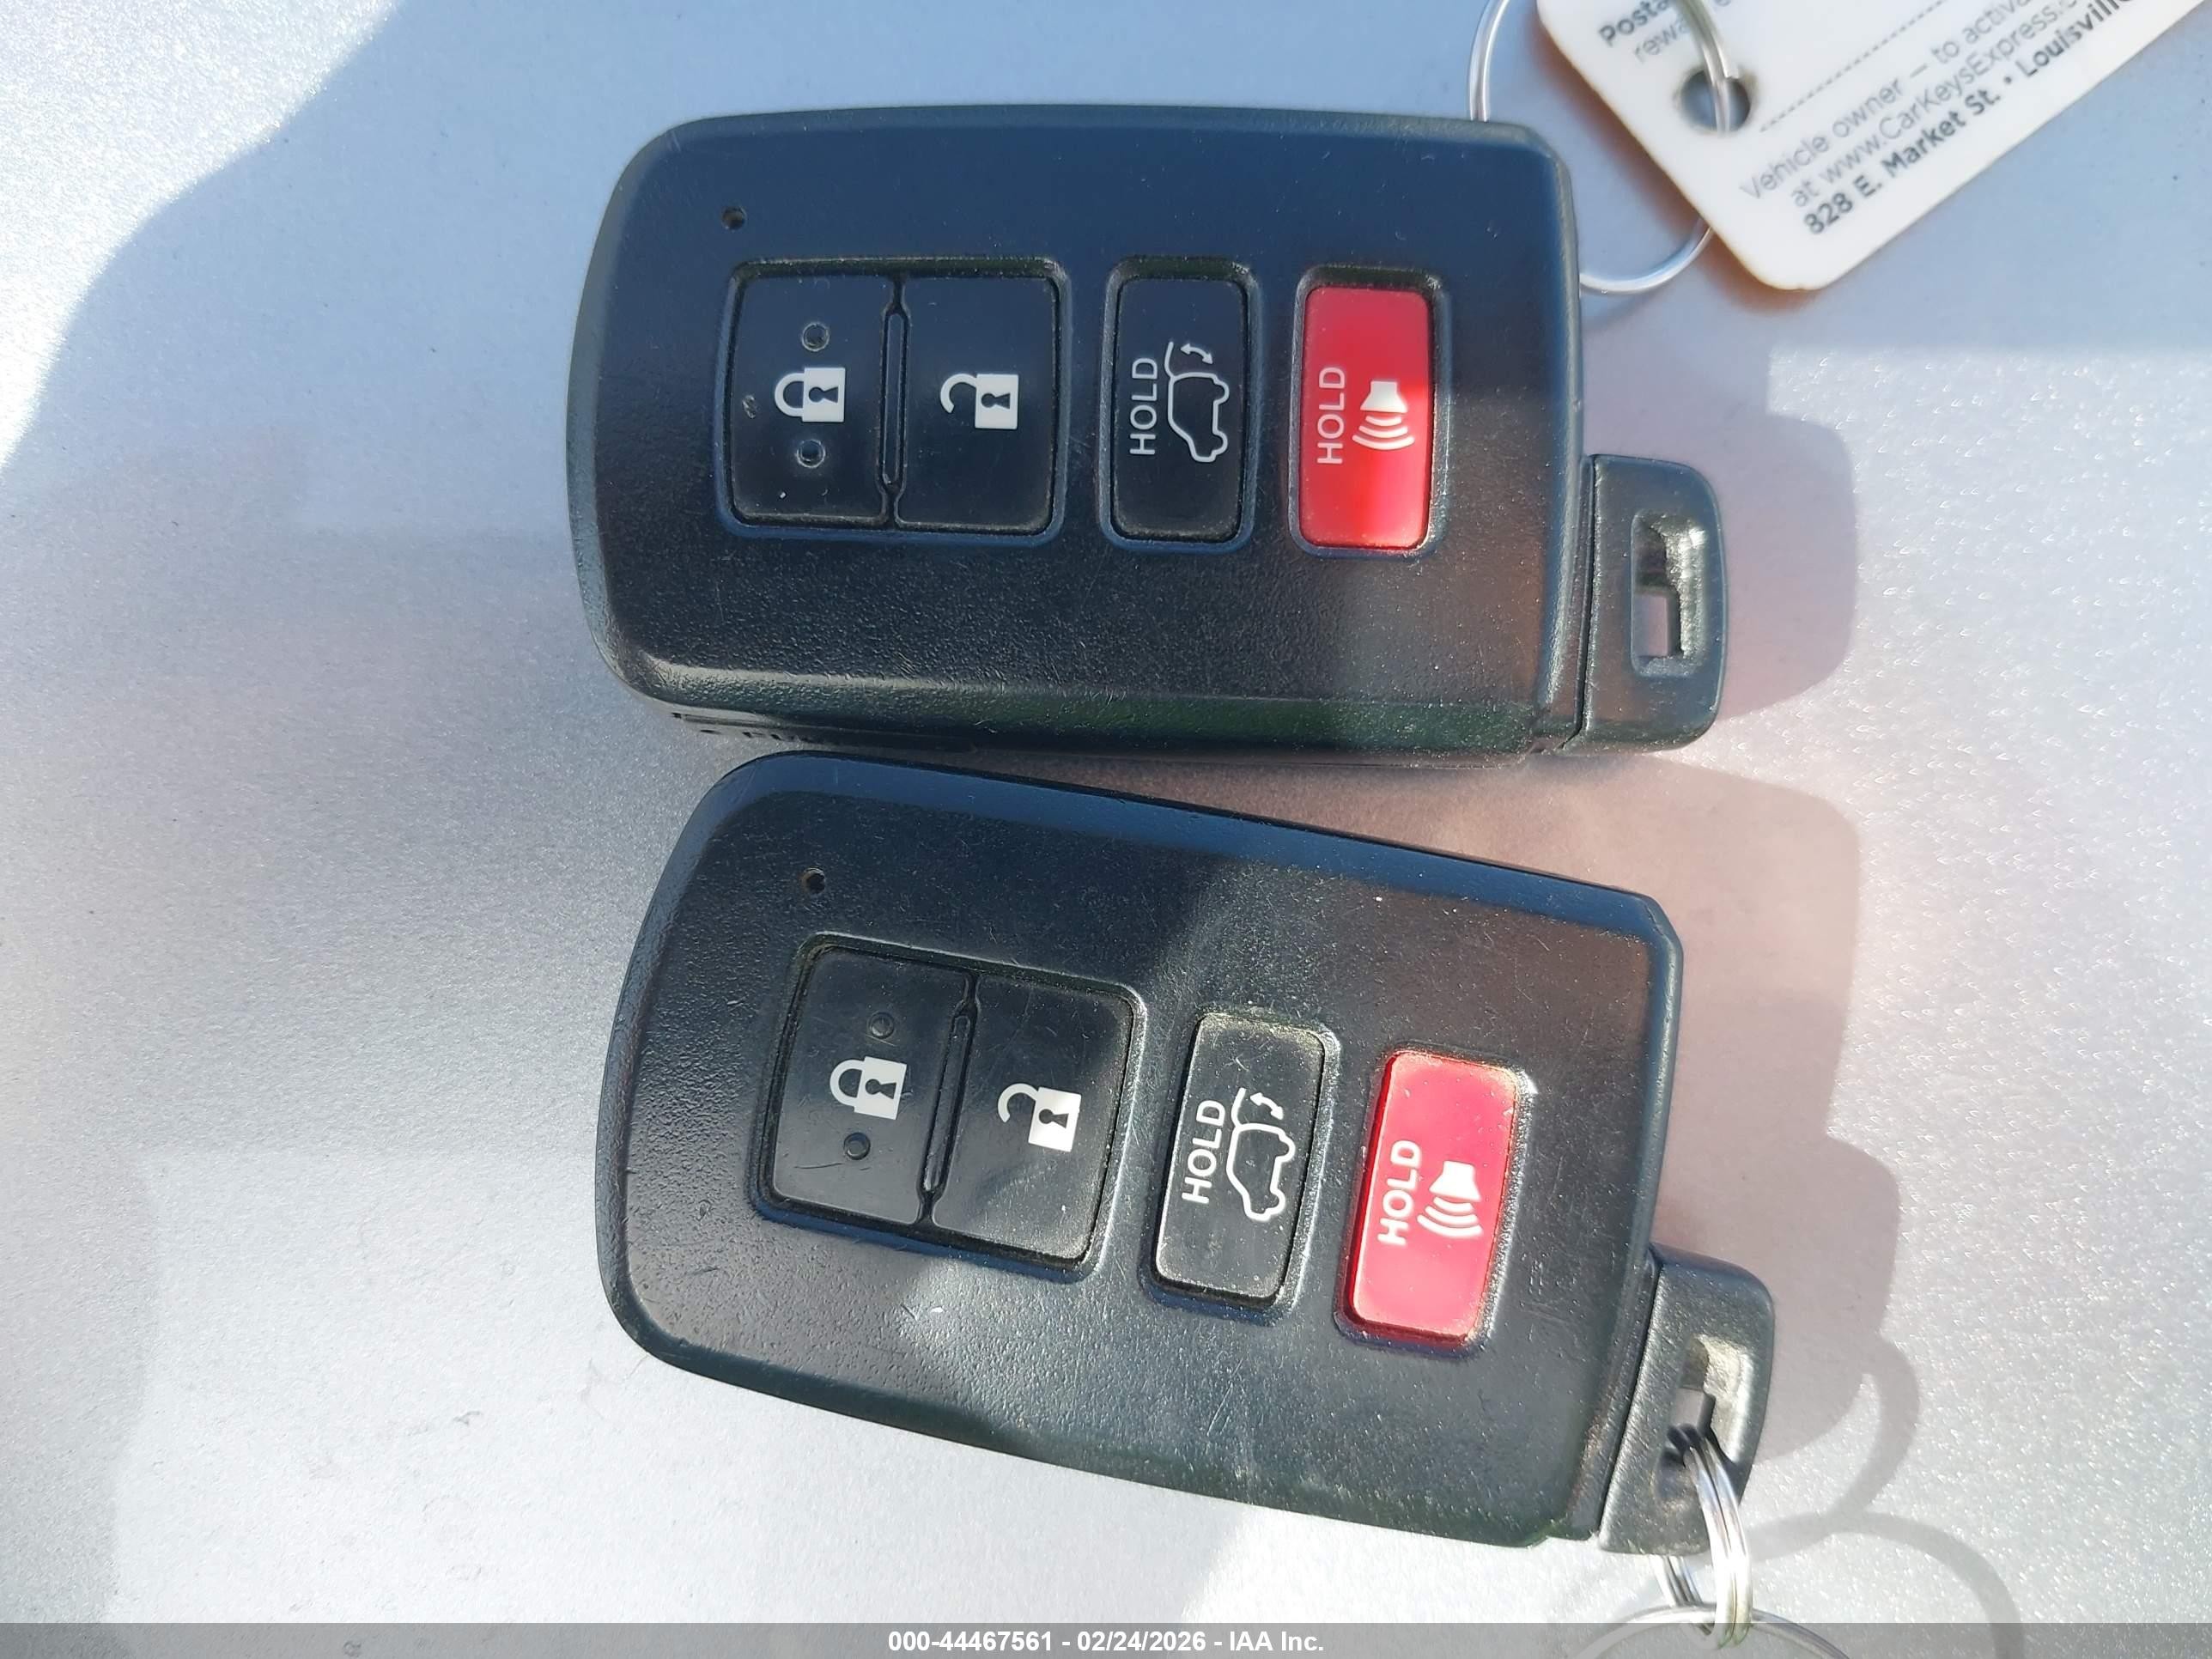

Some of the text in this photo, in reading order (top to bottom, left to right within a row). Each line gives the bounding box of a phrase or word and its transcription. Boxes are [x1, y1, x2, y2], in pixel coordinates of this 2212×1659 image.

[1599, 0, 1670, 48] Posta
[1635, 12, 1690, 64] rewa
[1740, 133, 1830, 201] Vehicle
[1832, 78, 1902, 137] owner
[1931, 41, 1960, 64] to
[1804, 191, 1853, 234] 828
[1853, 175, 1882, 198] E.
[1881, 111, 1966, 178] Market
[1965, 89, 2001, 115] St.
[2015, 0, 2132, 76] Louisvill
[1790, 179, 1820, 208] at
[1129, 357, 1157, 455] HOLD
[1316, 367, 1345, 465] HOLD
[1182, 1100, 1225, 1204] HOLD
[1378, 1140, 1422, 1245] HOLD
